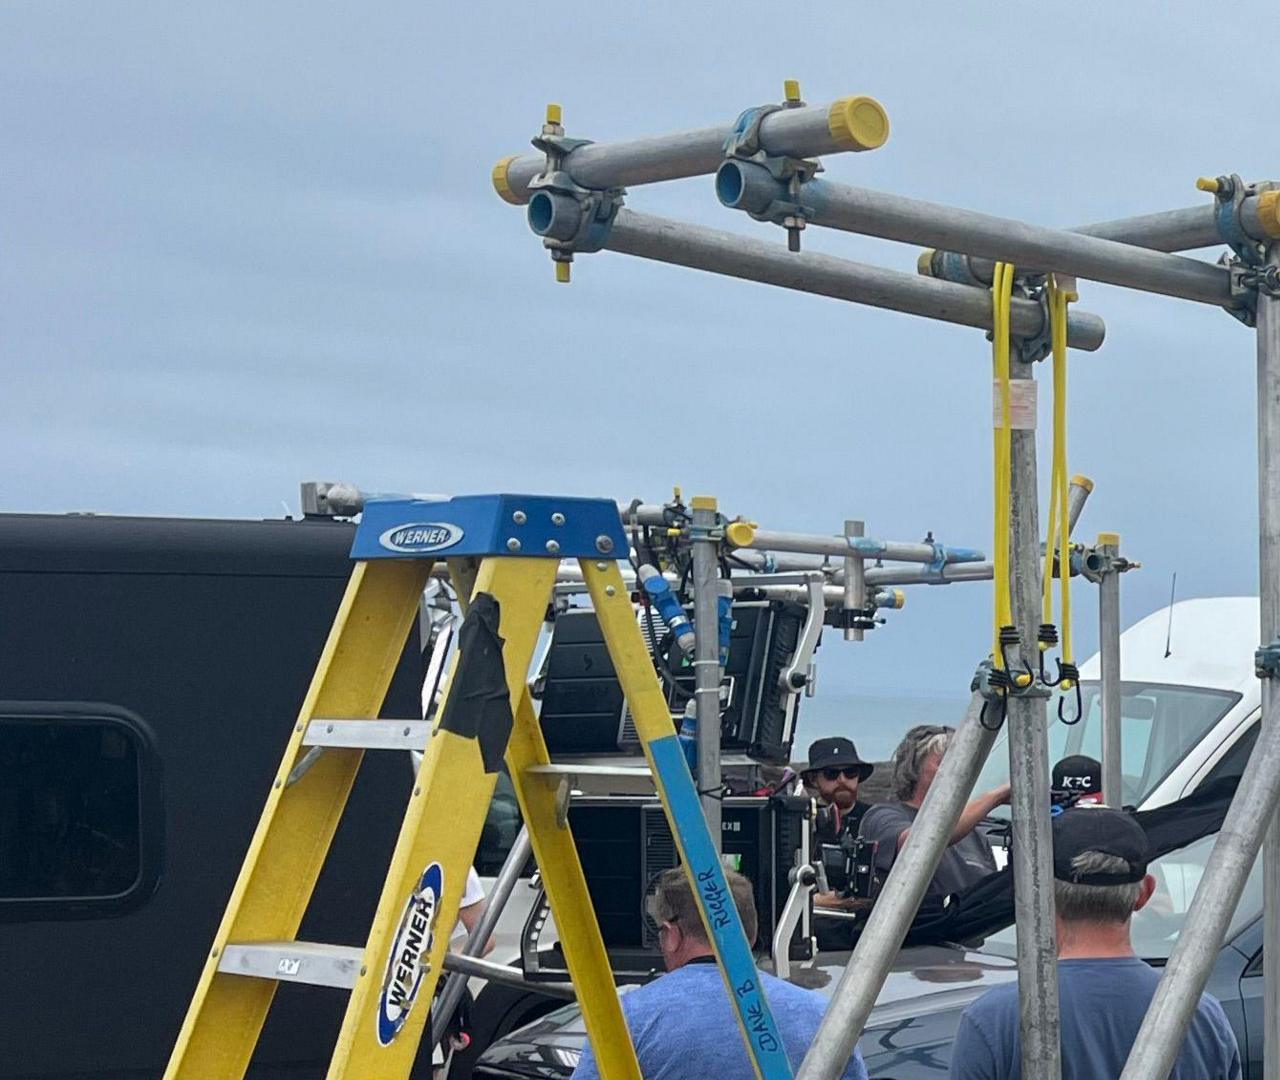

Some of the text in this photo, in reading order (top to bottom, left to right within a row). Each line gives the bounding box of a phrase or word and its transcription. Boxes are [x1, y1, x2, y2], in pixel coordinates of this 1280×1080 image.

[394, 528, 448, 545] WERNER
[1062, 776, 1091, 788] KFC
[388, 896, 432, 1008] WERNER
[698, 866, 778, 1052] DAVE B RIGGER
